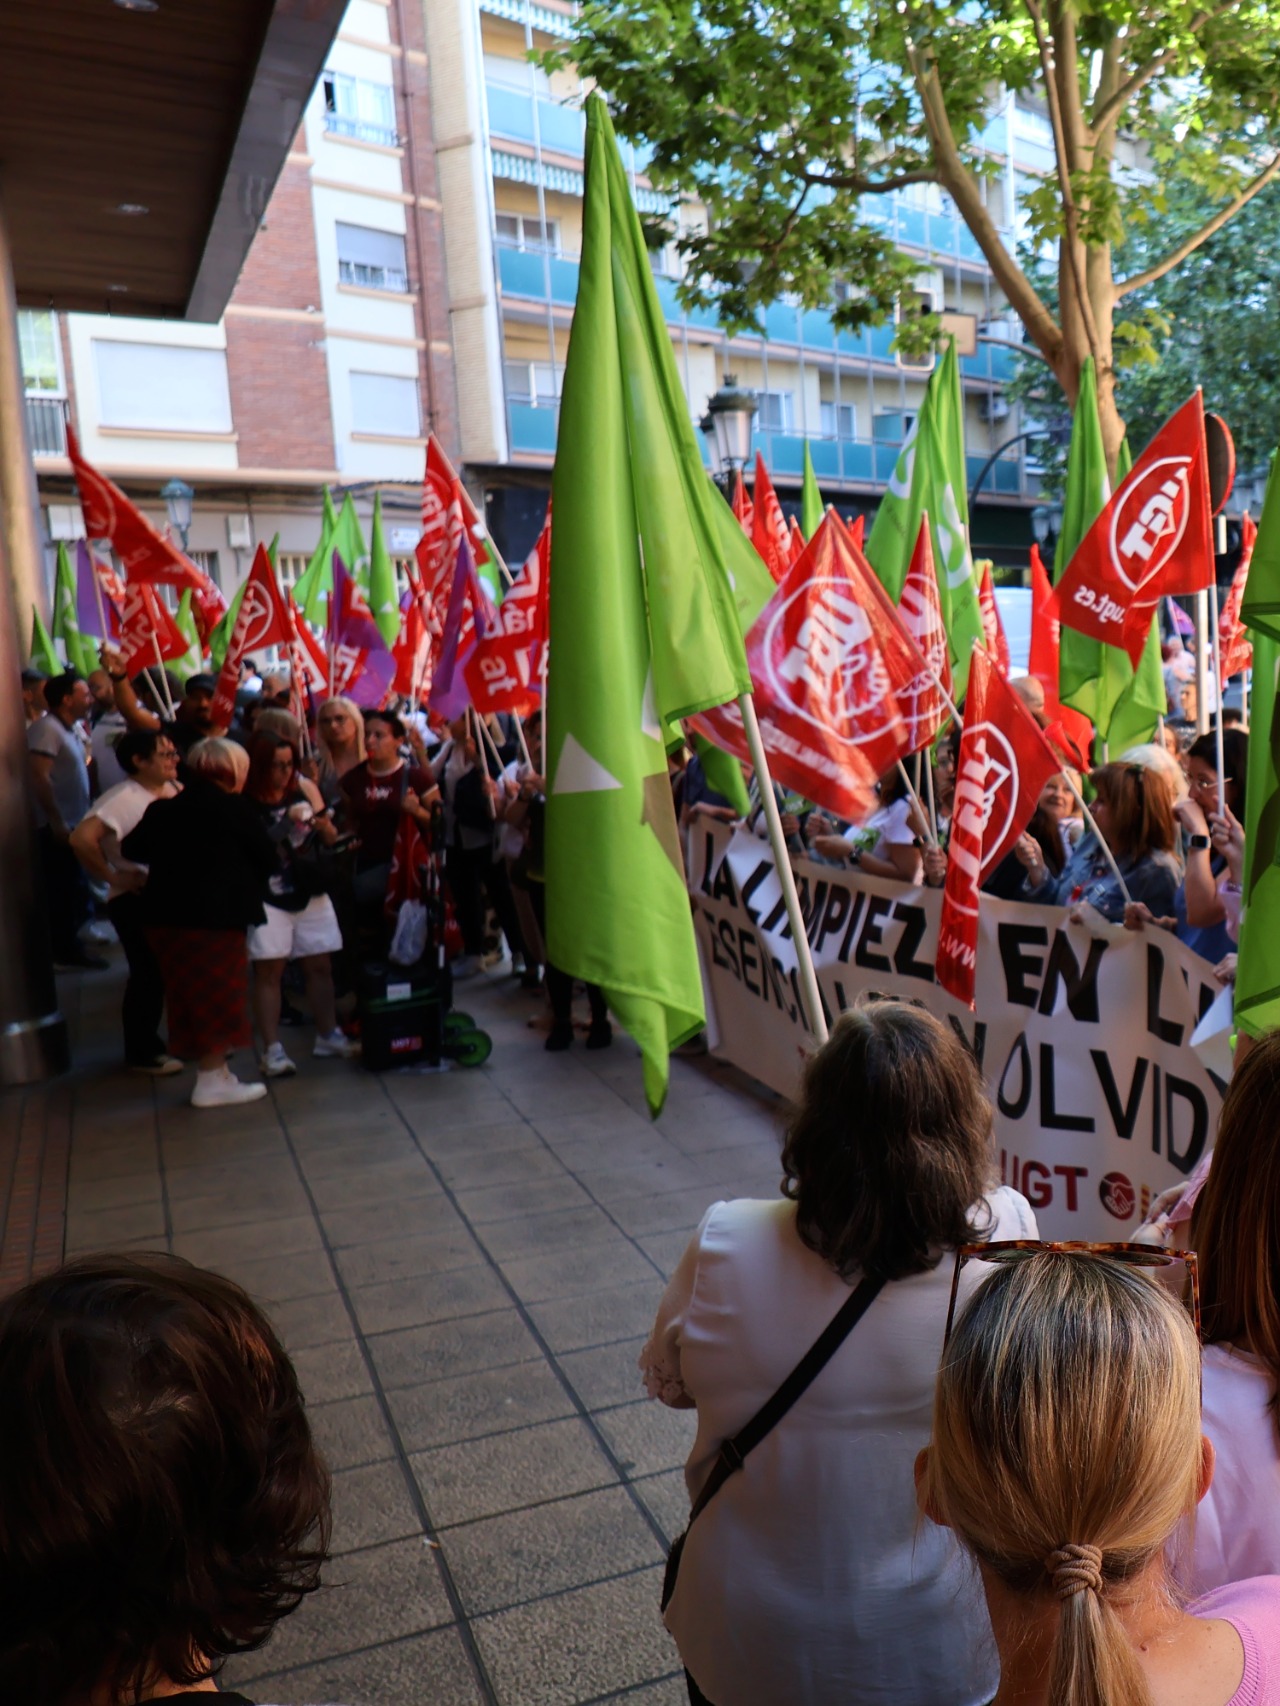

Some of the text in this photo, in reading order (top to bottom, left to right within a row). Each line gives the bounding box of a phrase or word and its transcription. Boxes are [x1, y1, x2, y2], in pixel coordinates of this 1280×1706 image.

[701, 832, 738, 908] LA
[742, 859, 938, 984] LIMPIEZ
[997, 922, 1109, 1023] EN
[998, 1031, 1230, 1175] OLVID
